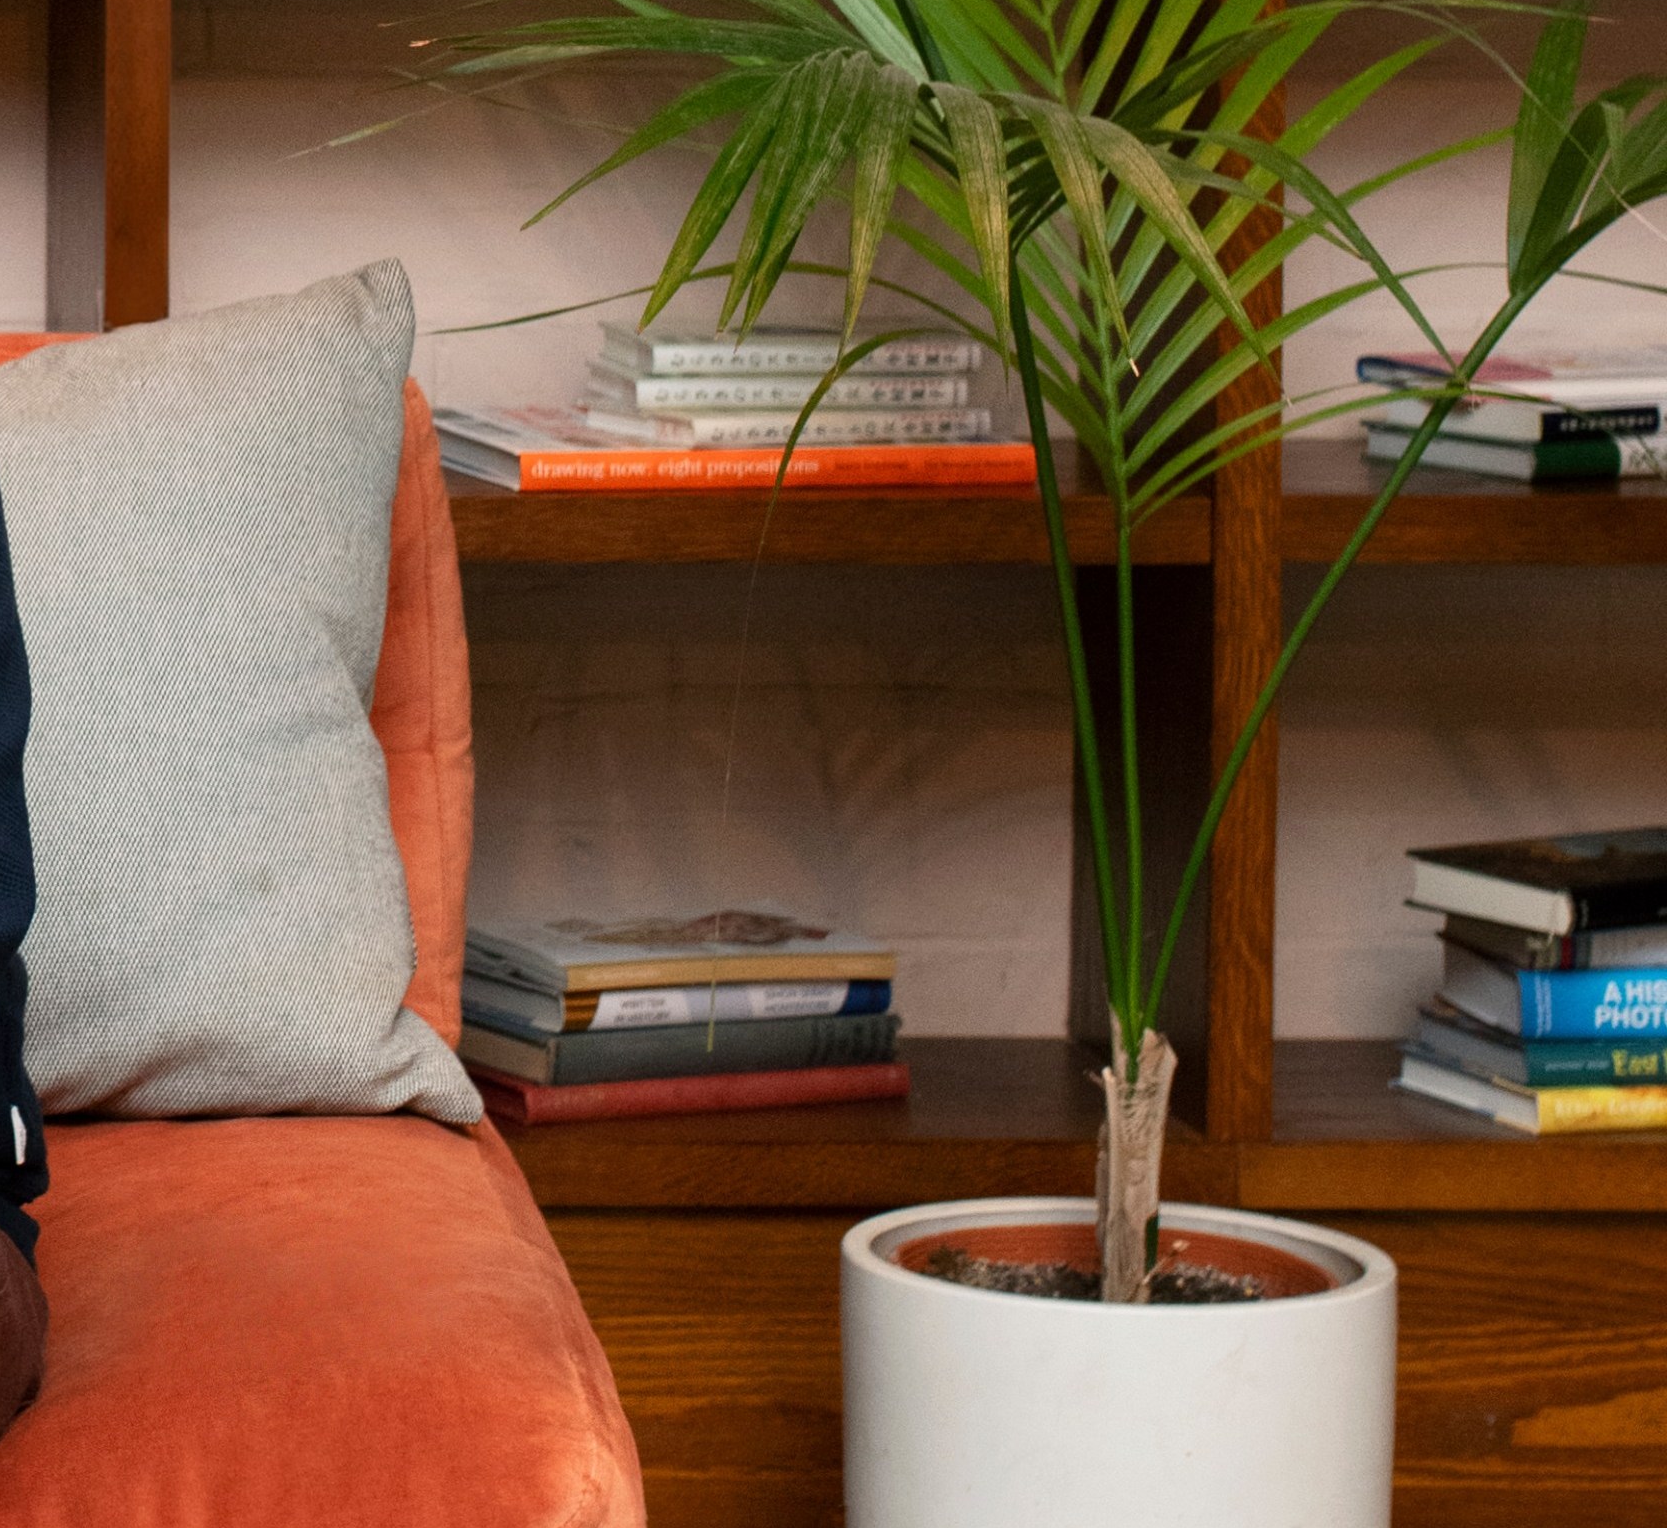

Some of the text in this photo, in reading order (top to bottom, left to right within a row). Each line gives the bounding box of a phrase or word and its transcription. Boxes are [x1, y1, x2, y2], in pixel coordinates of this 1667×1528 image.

[531, 458, 605, 481] drawing
[658, 455, 703, 478] eight
[1604, 981, 1622, 1004] A
